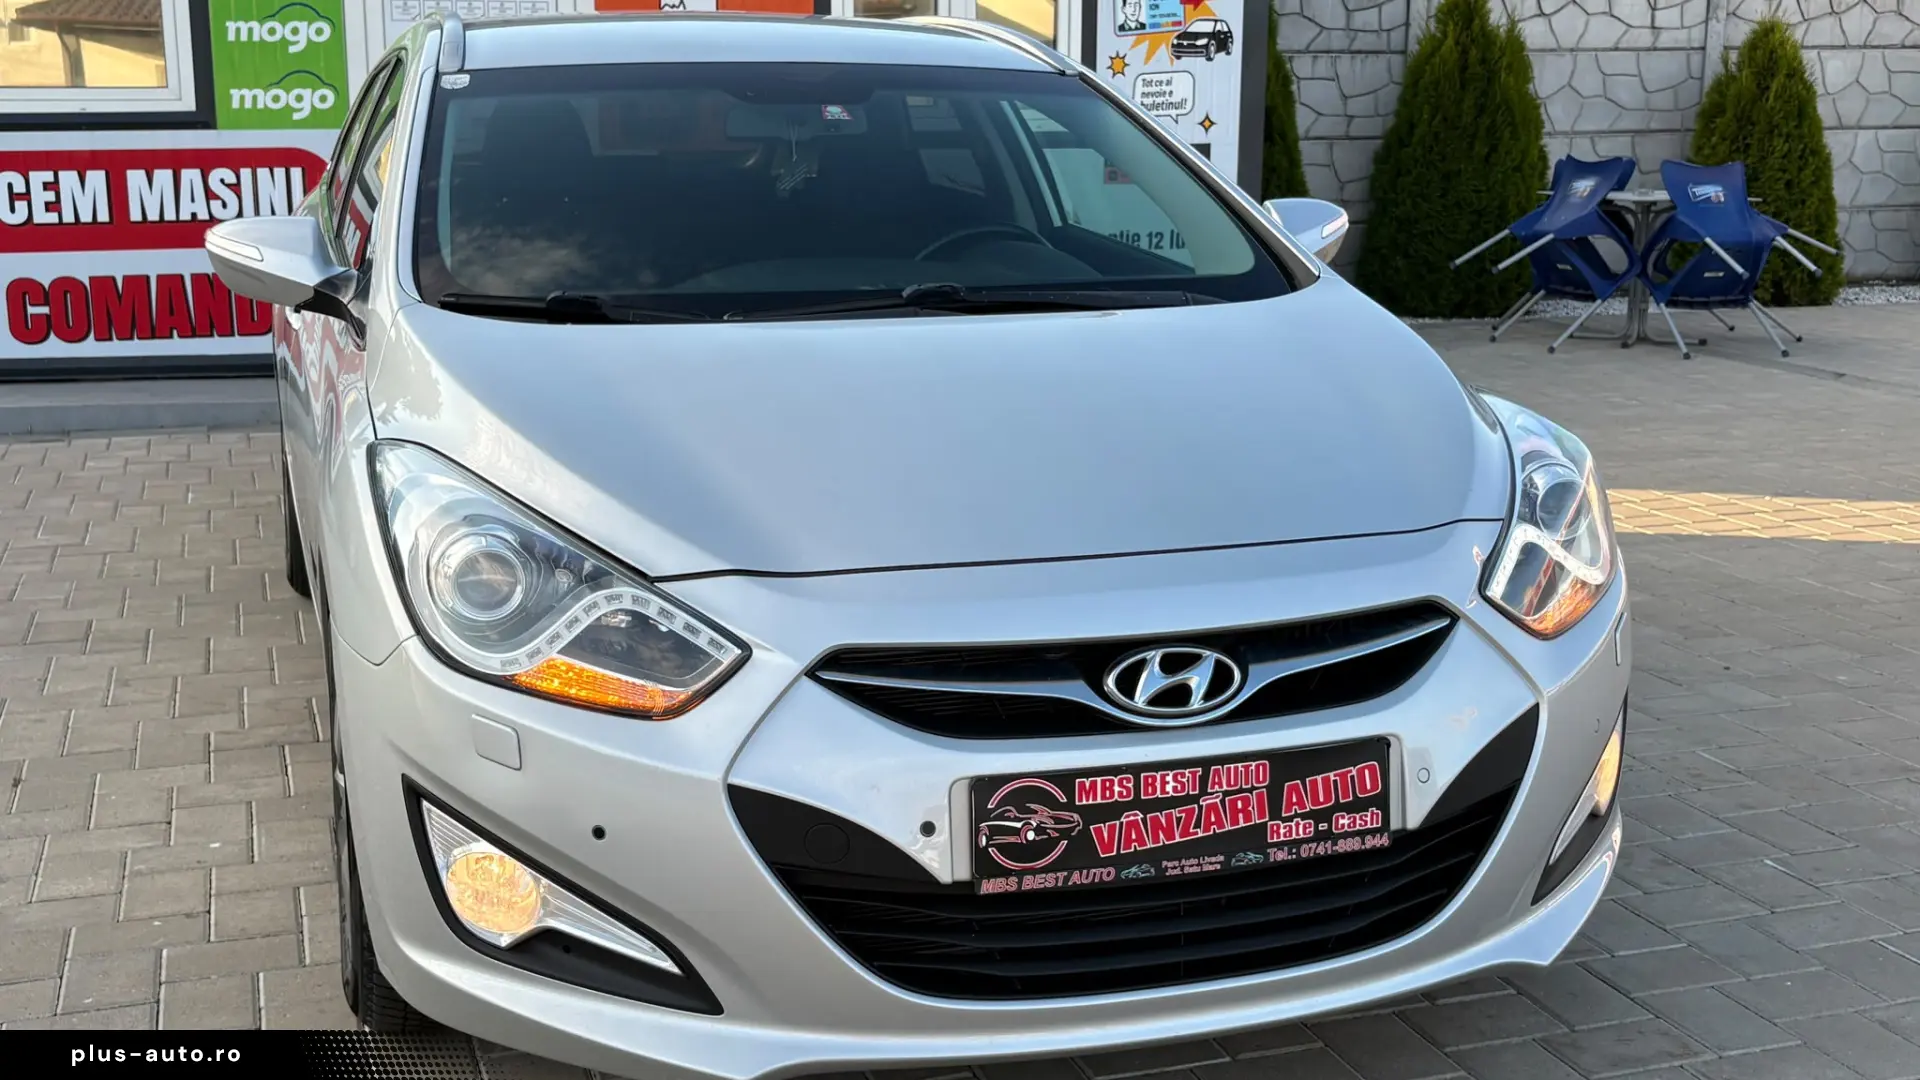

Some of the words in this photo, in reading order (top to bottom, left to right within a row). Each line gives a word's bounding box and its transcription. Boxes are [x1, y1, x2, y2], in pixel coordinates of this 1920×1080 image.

[226, 20, 331, 53] mogo
[1141, 78, 1154, 88] Tot
[1165, 77, 1173, 86] ai
[1141, 89, 1167, 99] nevoie
[230, 88, 335, 120] mogo
[0, 169, 112, 225] CEM
[125, 166, 306, 223] MASINI
[1146, 231, 1164, 250] 12
[6, 273, 272, 345] COMAND
[1075, 774, 1133, 805] MBS
[1141, 768, 1201, 799] BEST
[1207, 760, 1270, 793] AUTO
[1281, 761, 1382, 817] AUTO
[1267, 818, 1314, 842] Rate
[1332, 808, 1381, 832] Cash
[1180, 857, 1198, 868] Auto
[1267, 846, 1297, 862] Tel.:
[980, 876, 1018, 896] MBS
[1021, 871, 1067, 890] BEST
[1067, 866, 1116, 886] AUTO
